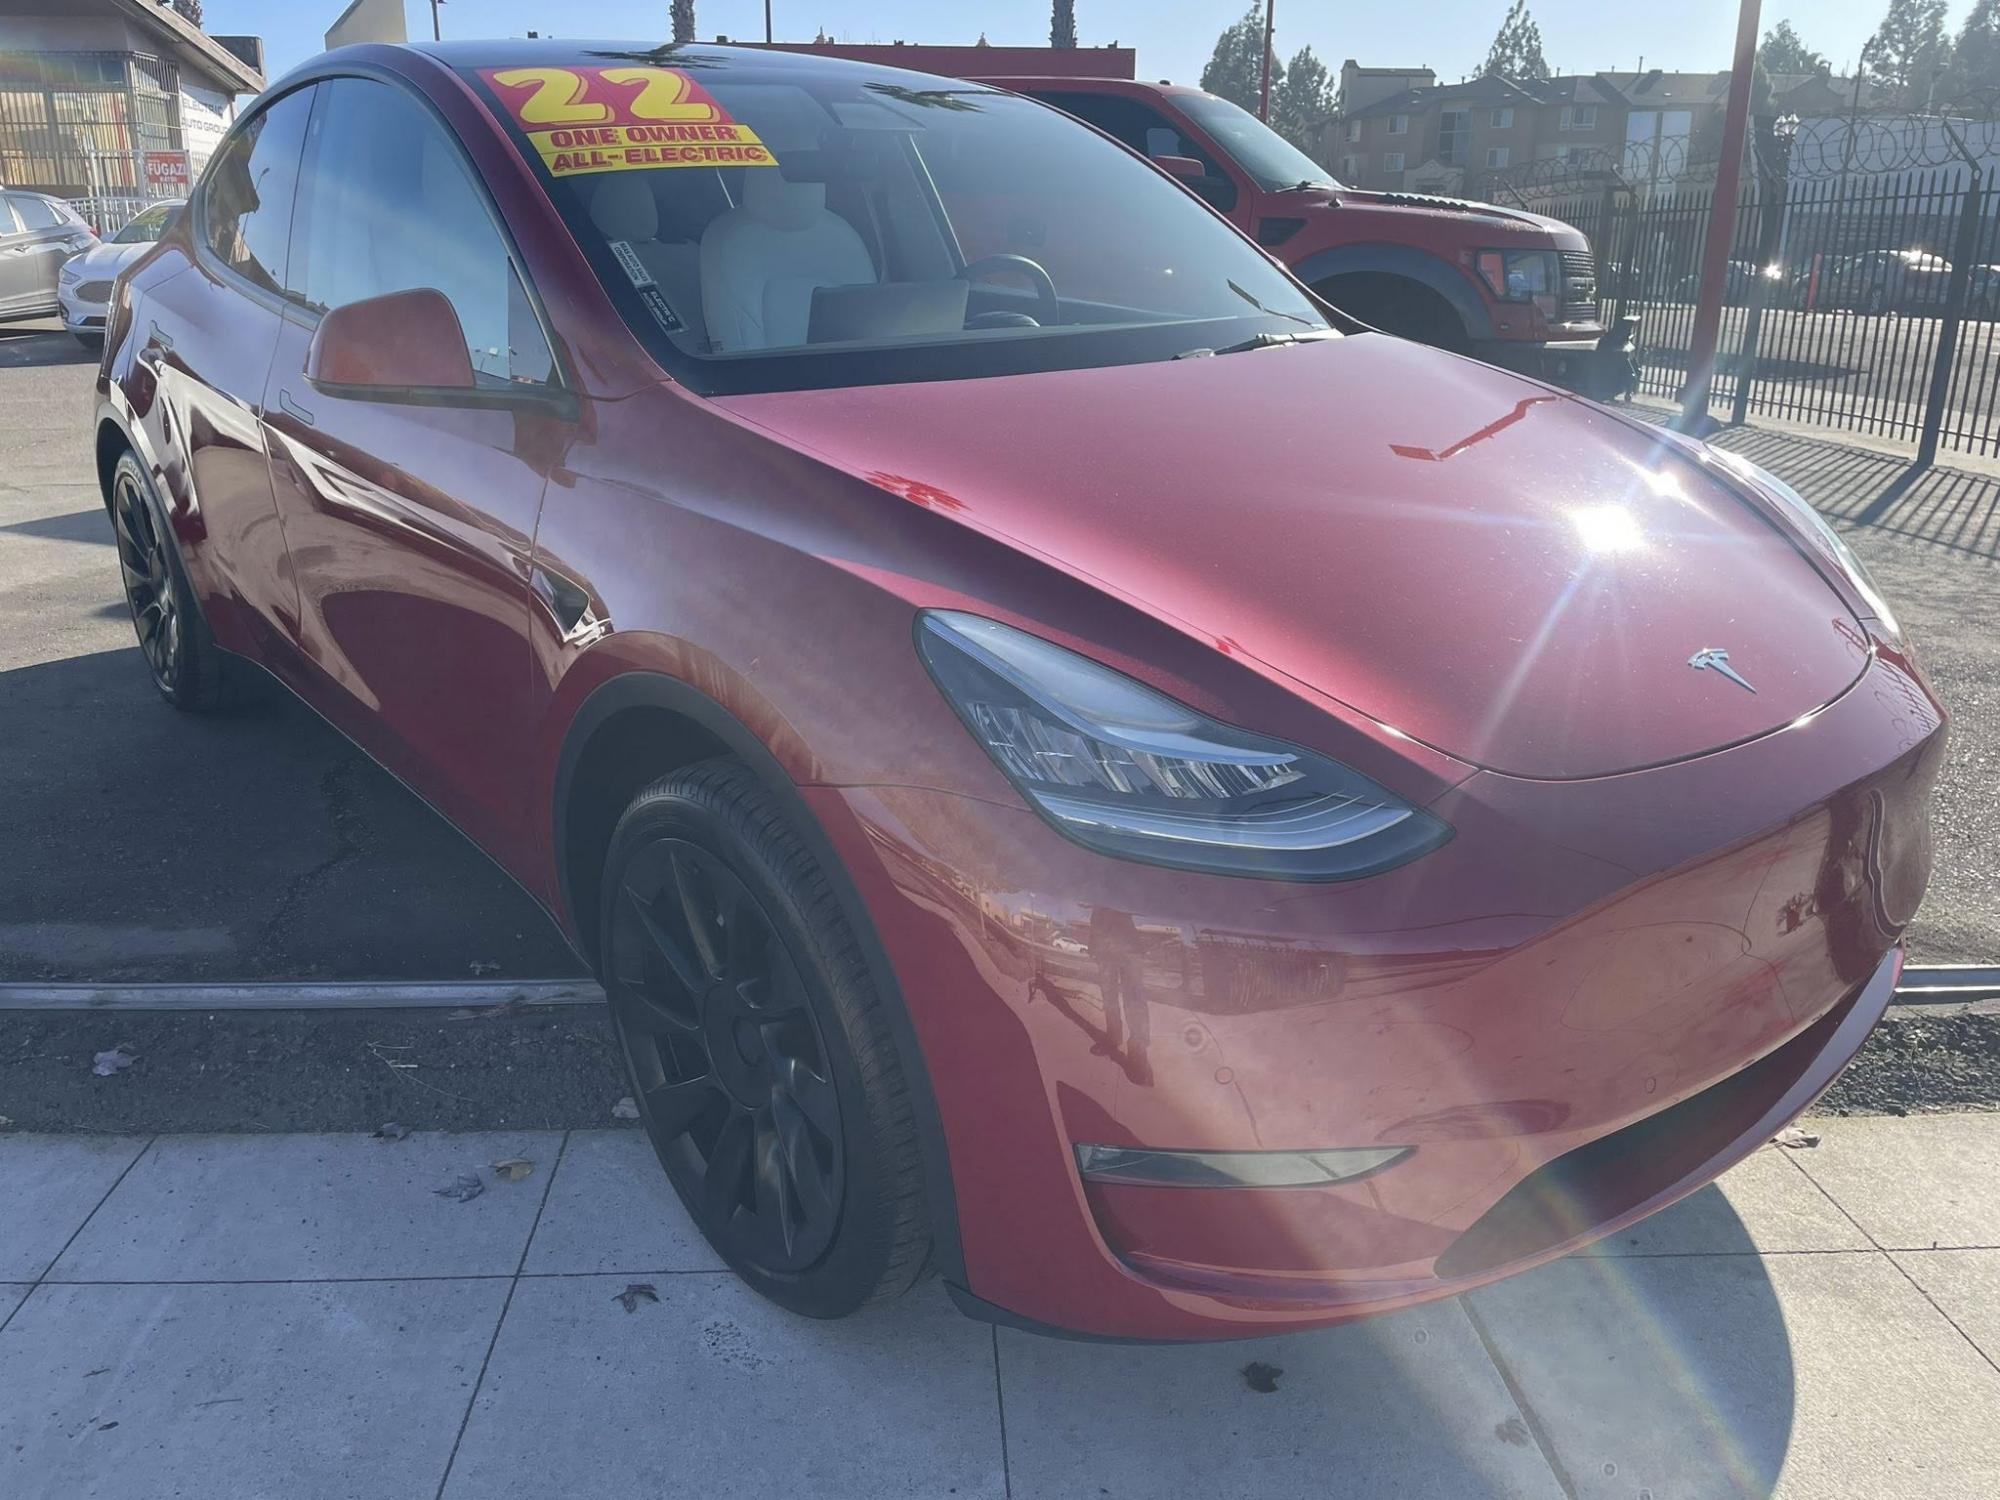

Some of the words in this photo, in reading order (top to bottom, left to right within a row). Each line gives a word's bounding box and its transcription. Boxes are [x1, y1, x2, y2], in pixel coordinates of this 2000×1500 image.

[493, 68, 719, 125] 22
[182, 116, 203, 130] AUTO
[550, 129, 621, 149] ONE
[626, 126, 741, 143] OWNER
[148, 162, 186, 176] FUGAZI
[552, 146, 768, 172] ALL-ELECTRIC
